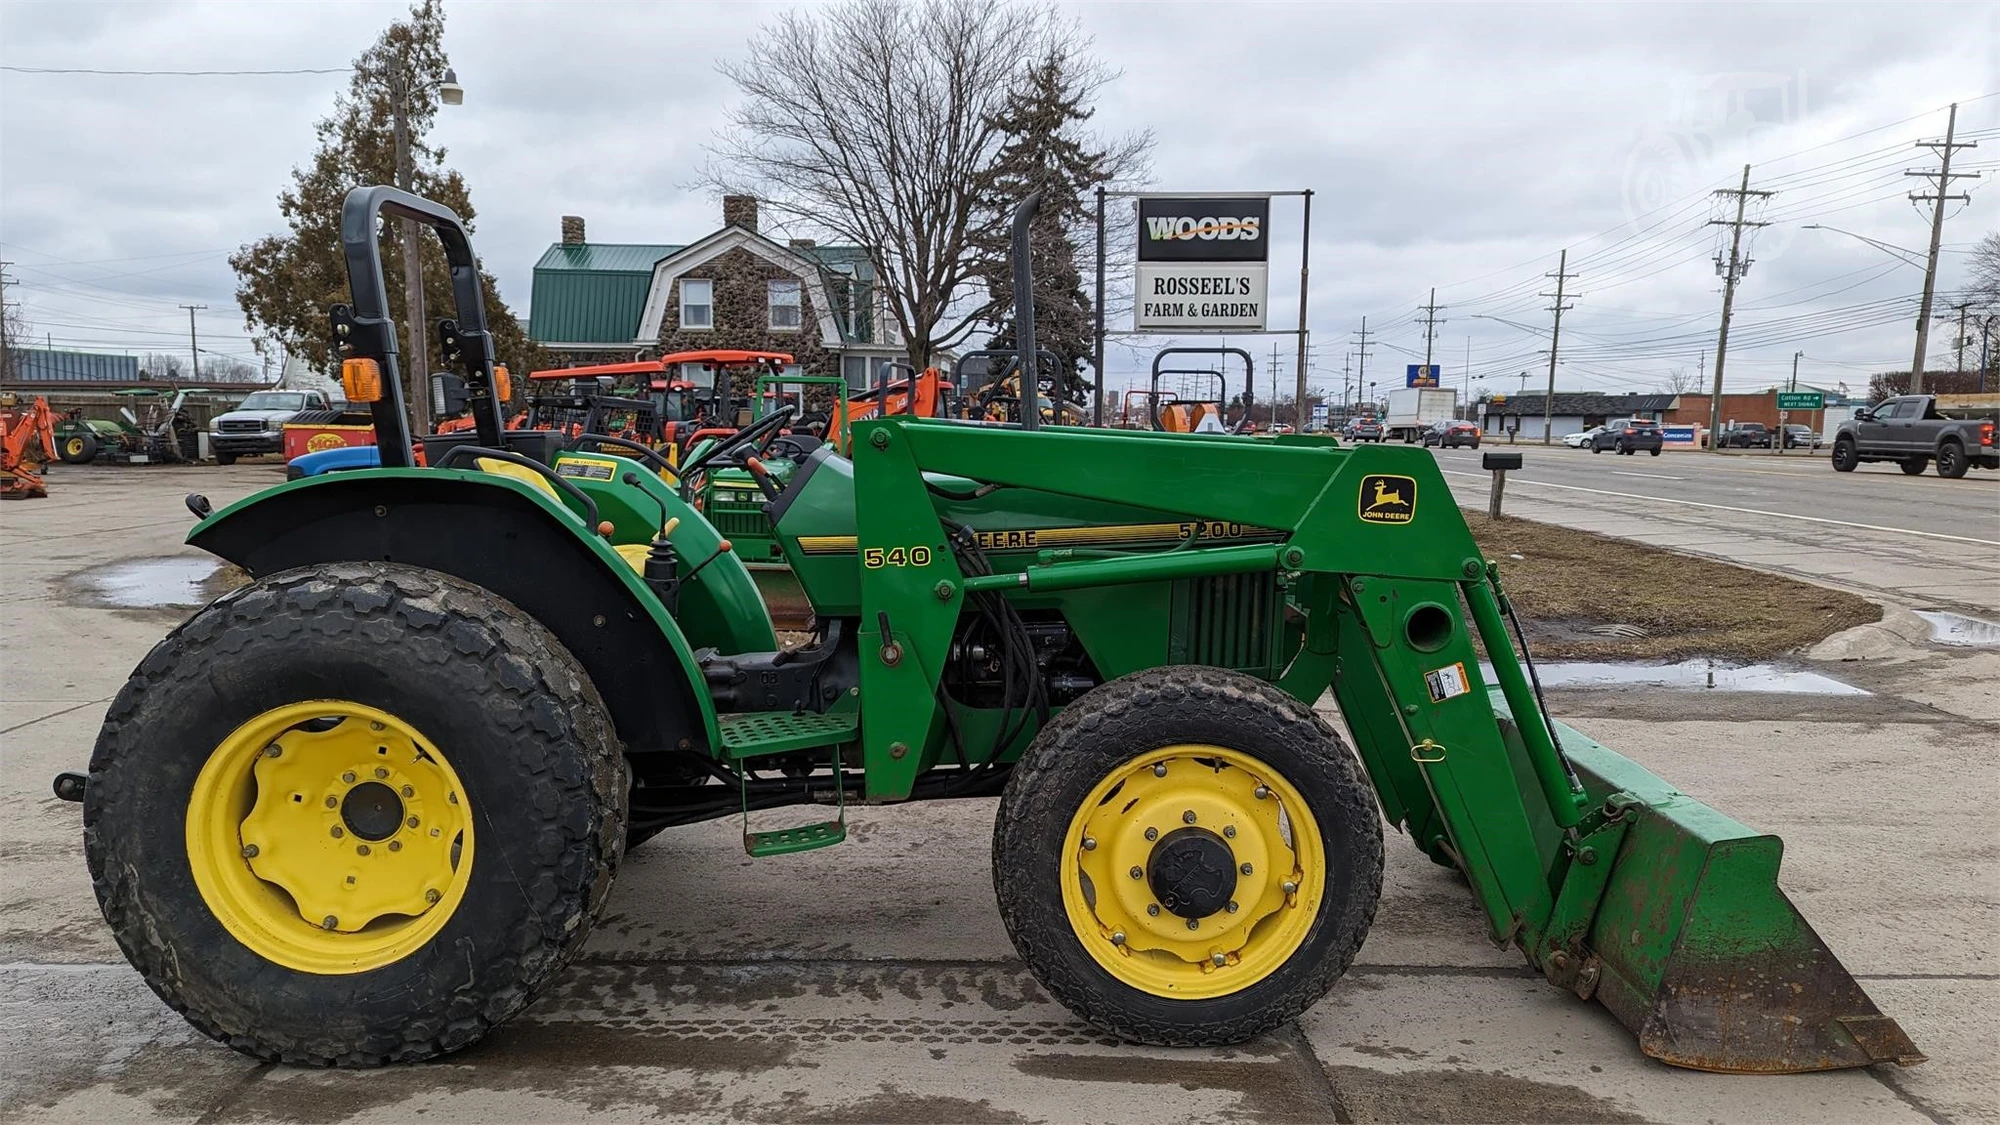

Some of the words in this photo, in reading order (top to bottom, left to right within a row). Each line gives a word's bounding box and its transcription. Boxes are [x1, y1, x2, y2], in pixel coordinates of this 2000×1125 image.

[1147, 217, 1260, 241] WOODS
[1154, 277, 1251, 295] ROSSEEL'S
[1144, 303, 1184, 317] FARM
[1187, 303, 1198, 317] &
[1201, 303, 1258, 317] GARDEN
[1385, 512, 1410, 520] DEERE
[865, 546, 931, 568] 540
